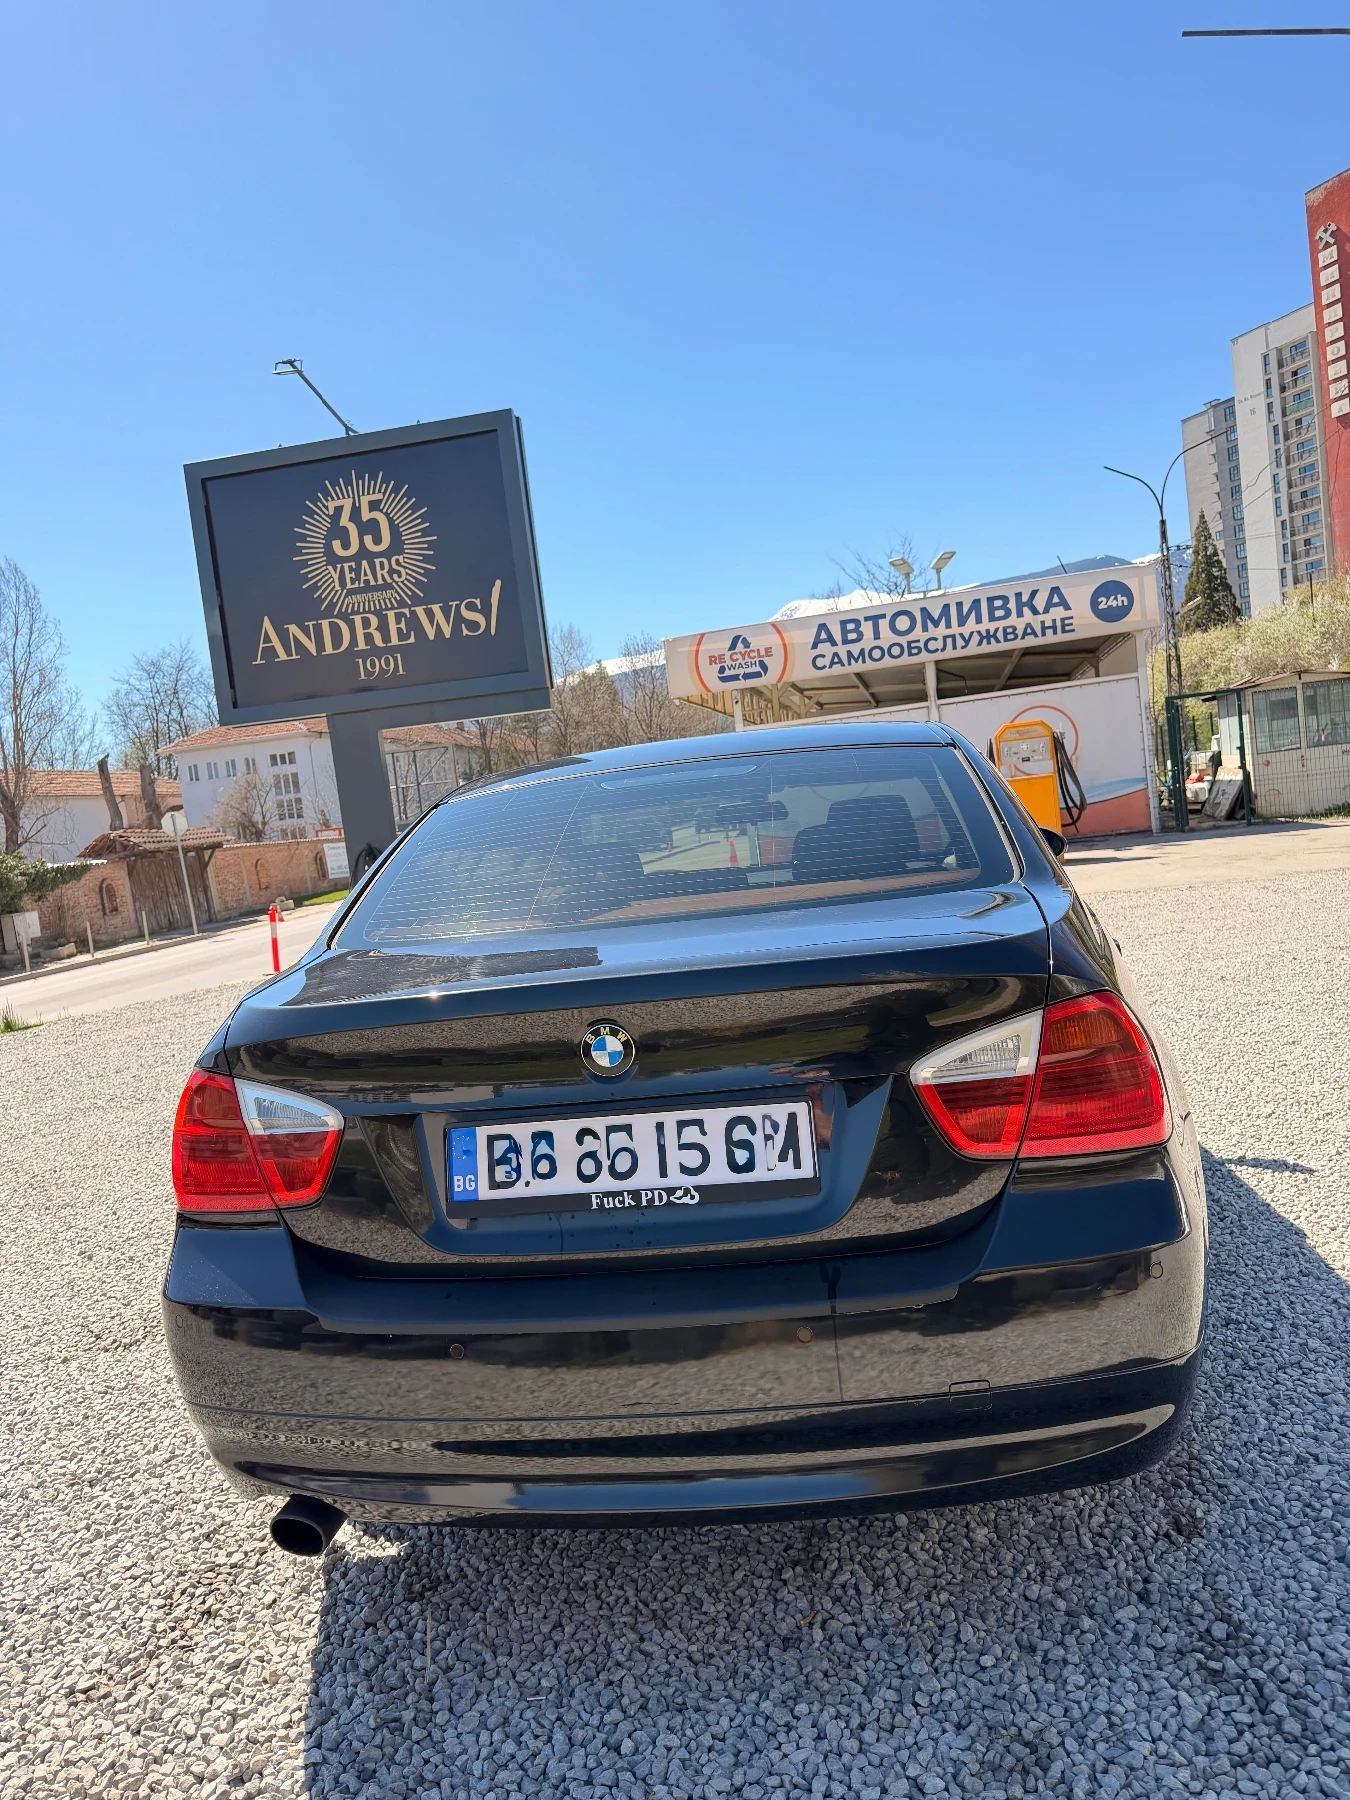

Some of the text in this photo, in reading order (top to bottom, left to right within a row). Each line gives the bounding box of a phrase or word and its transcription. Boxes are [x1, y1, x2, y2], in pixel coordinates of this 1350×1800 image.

[328, 493, 392, 558] 35
[326, 554, 407, 591] YEARS
[346, 589, 397, 605] ANNIVERSARY
[1096, 594, 1128, 611] 24h
[810, 585, 1073, 651] АВТОМИВКА
[810, 616, 1076, 672] САМООБСЛУЖВАНЕ
[356, 653, 406, 680] 1991
[726, 660, 758, 672] WASH
[585, 1026, 628, 1045] BMW
[453, 1175, 476, 1193] BG
[589, 1189, 668, 1210] Fuck PD
